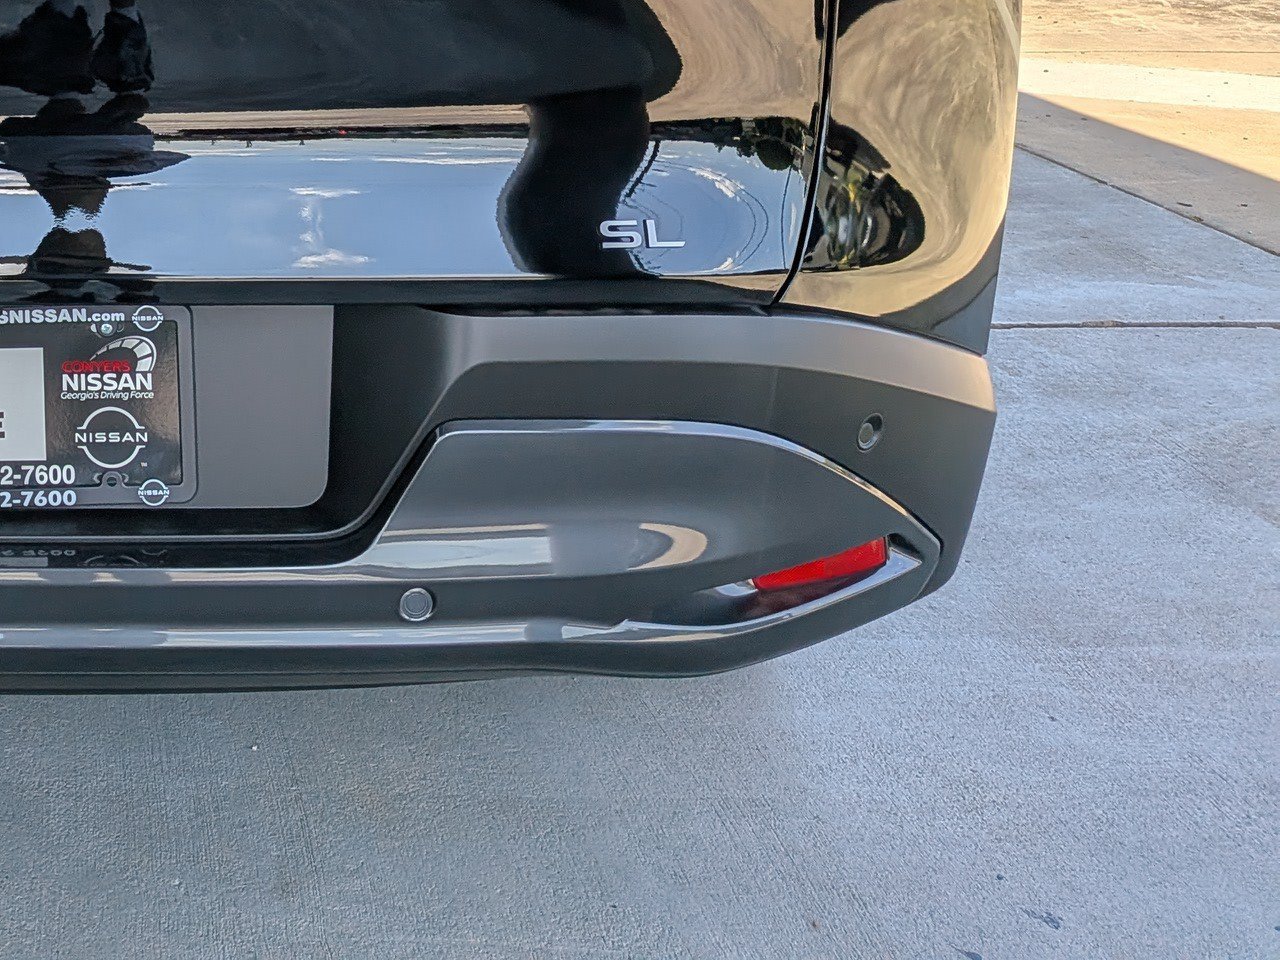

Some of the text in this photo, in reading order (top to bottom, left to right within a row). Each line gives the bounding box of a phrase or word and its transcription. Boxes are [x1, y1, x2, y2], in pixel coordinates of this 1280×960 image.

[599, 219, 686, 249] SL
[61, 360, 132, 373] CONYERS
[62, 373, 153, 391] NISSAN
[61, 390, 154, 401] Georgia's Driving Force
[75, 432, 148, 443] NISSAN
